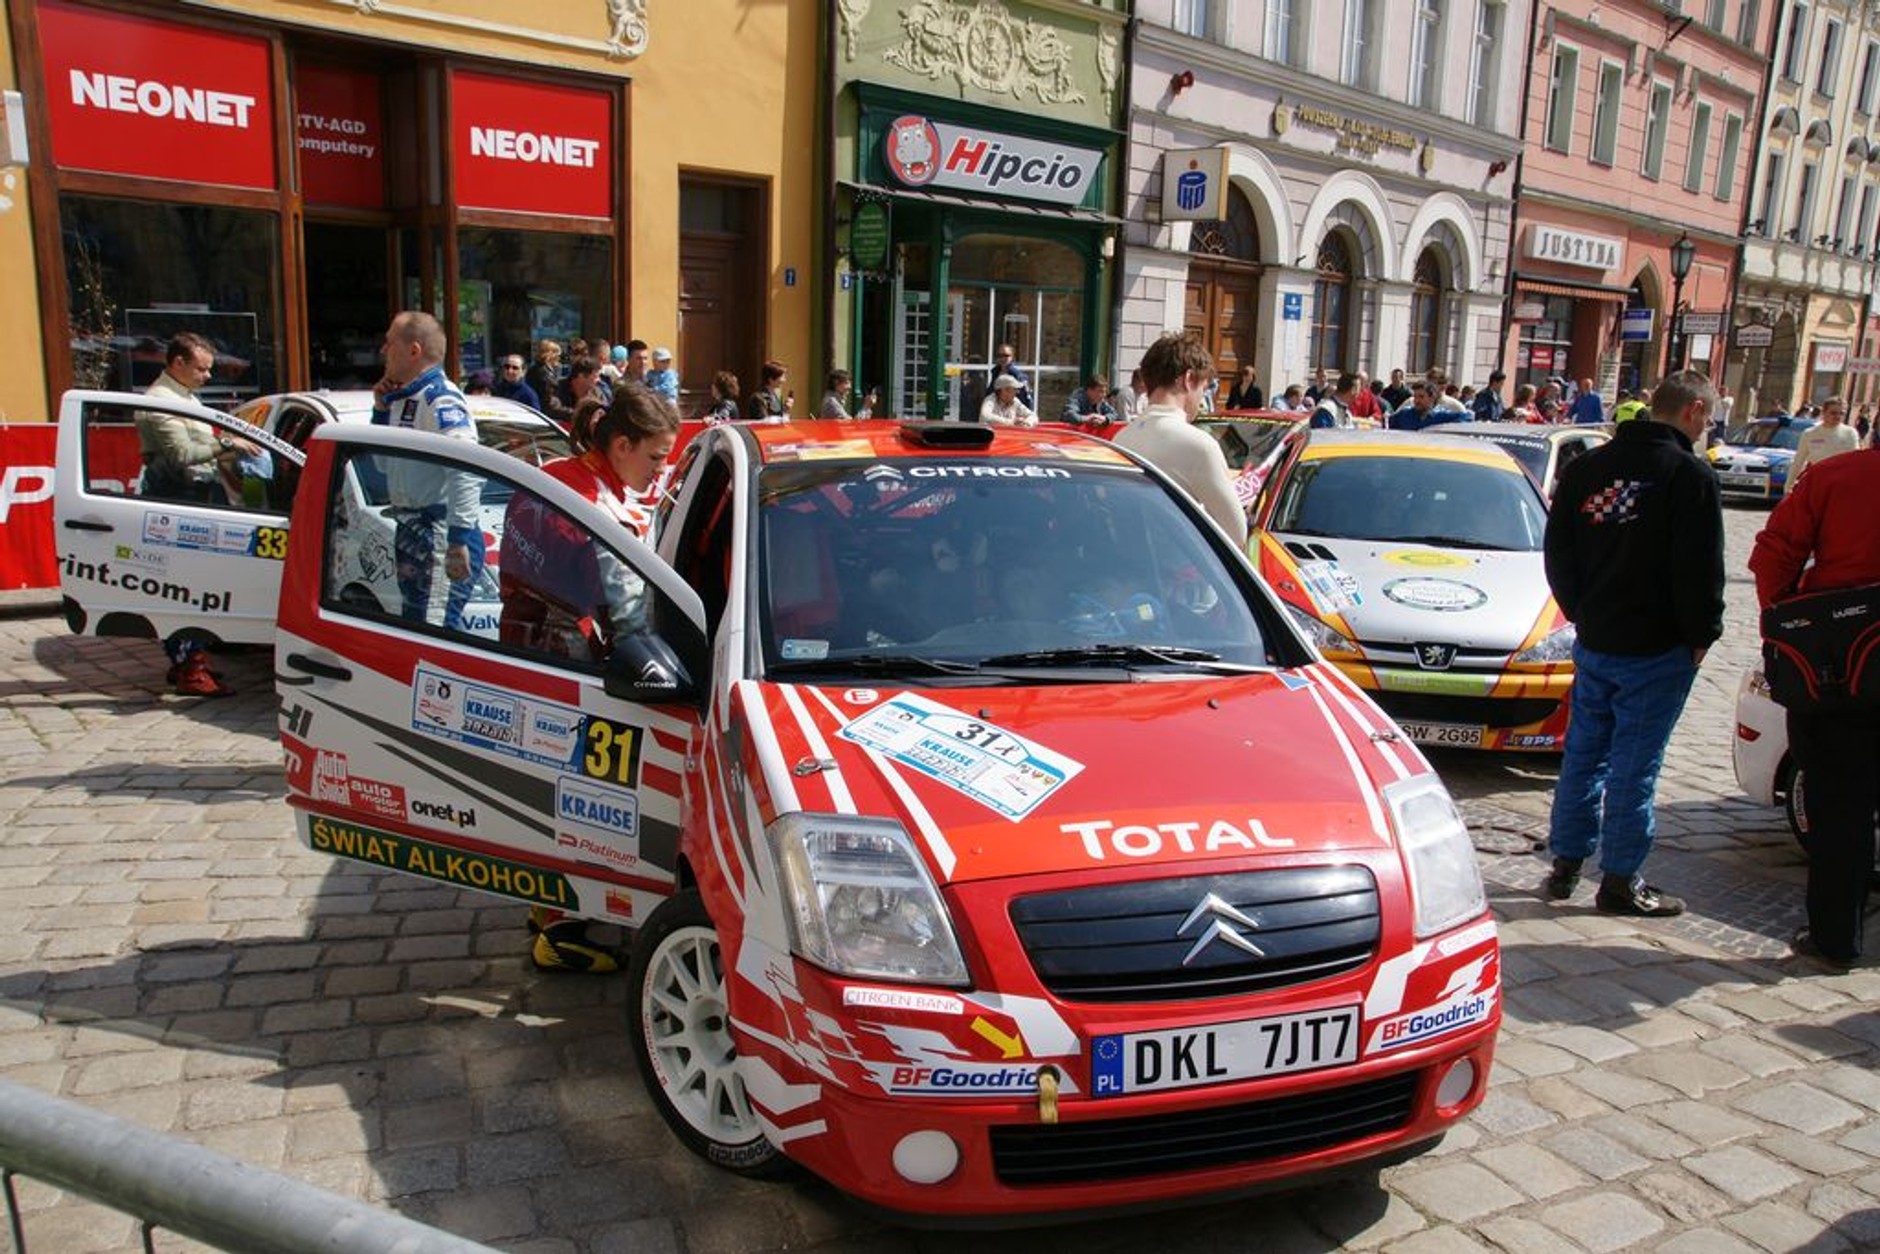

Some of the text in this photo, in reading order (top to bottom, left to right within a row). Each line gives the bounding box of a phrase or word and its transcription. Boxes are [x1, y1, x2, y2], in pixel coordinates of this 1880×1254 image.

[69, 69, 255, 128] NEONET
[470, 126, 599, 168] NEONET
[945, 136, 1082, 191] Hipcio
[1540, 232, 1616, 266] JUSTYNA
[256, 528, 287, 559] 33
[466, 700, 512, 722] KRAUSE
[585, 720, 633, 784] 31
[956, 722, 1000, 749] 31
[1437, 727, 1480, 743] 2G95
[921, 738, 976, 767] KRAUSE
[351, 780, 392, 797] auto
[411, 797, 476, 829] onet.pl
[562, 793, 633, 830] KRAUSE
[580, 839, 637, 865] Platinum
[1060, 818, 1295, 860] TOTAL
[313, 817, 566, 904] ŚWIAT ALKOHOLI
[916, 997, 960, 1011] BANK
[1382, 995, 1485, 1041] BFGoodrich
[1096, 1013, 1352, 1094] PL DKL 7JT7
